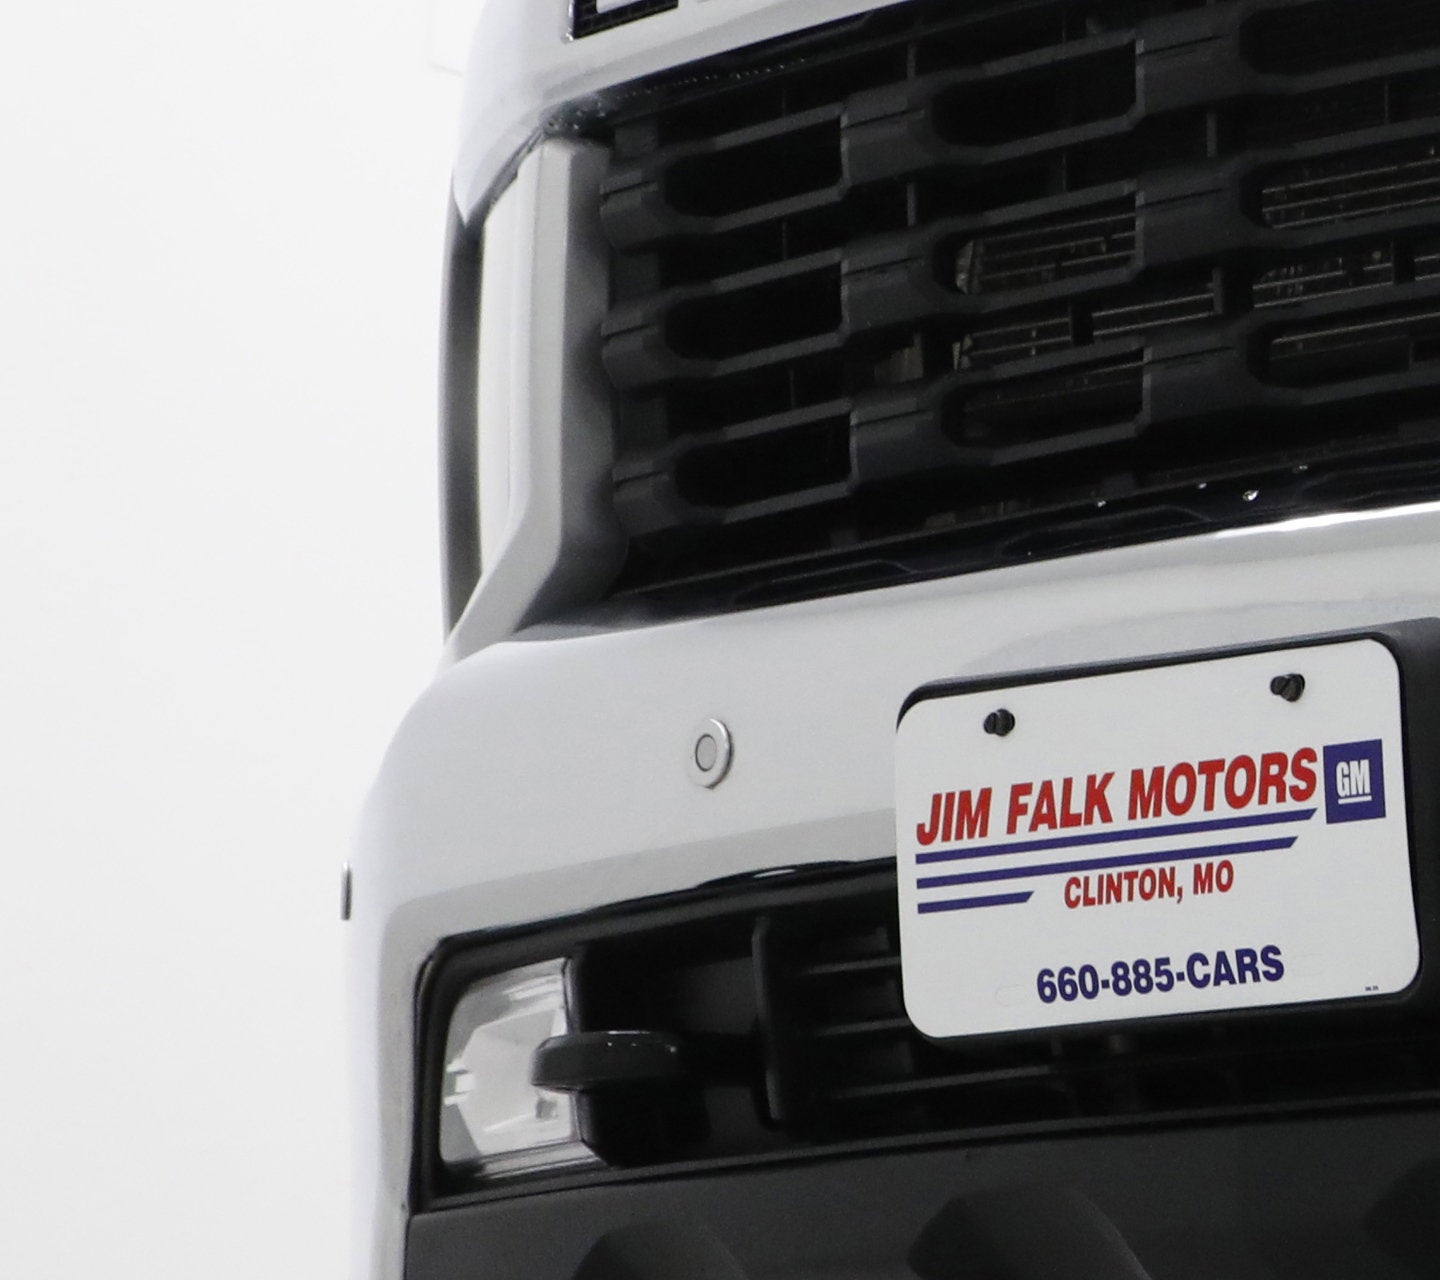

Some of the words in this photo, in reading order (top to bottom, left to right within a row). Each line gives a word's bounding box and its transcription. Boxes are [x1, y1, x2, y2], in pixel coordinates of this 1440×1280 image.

[916, 789, 992, 846] JIM
[1006, 772, 1115, 835] FALK
[1128, 747, 1318, 821] MOTORS
[1336, 759, 1372, 797] GM
[1064, 865, 1183, 910] CLINTON,
[1193, 859, 1234, 896] MO
[1037, 944, 1285, 1004] 660-885-CARS
